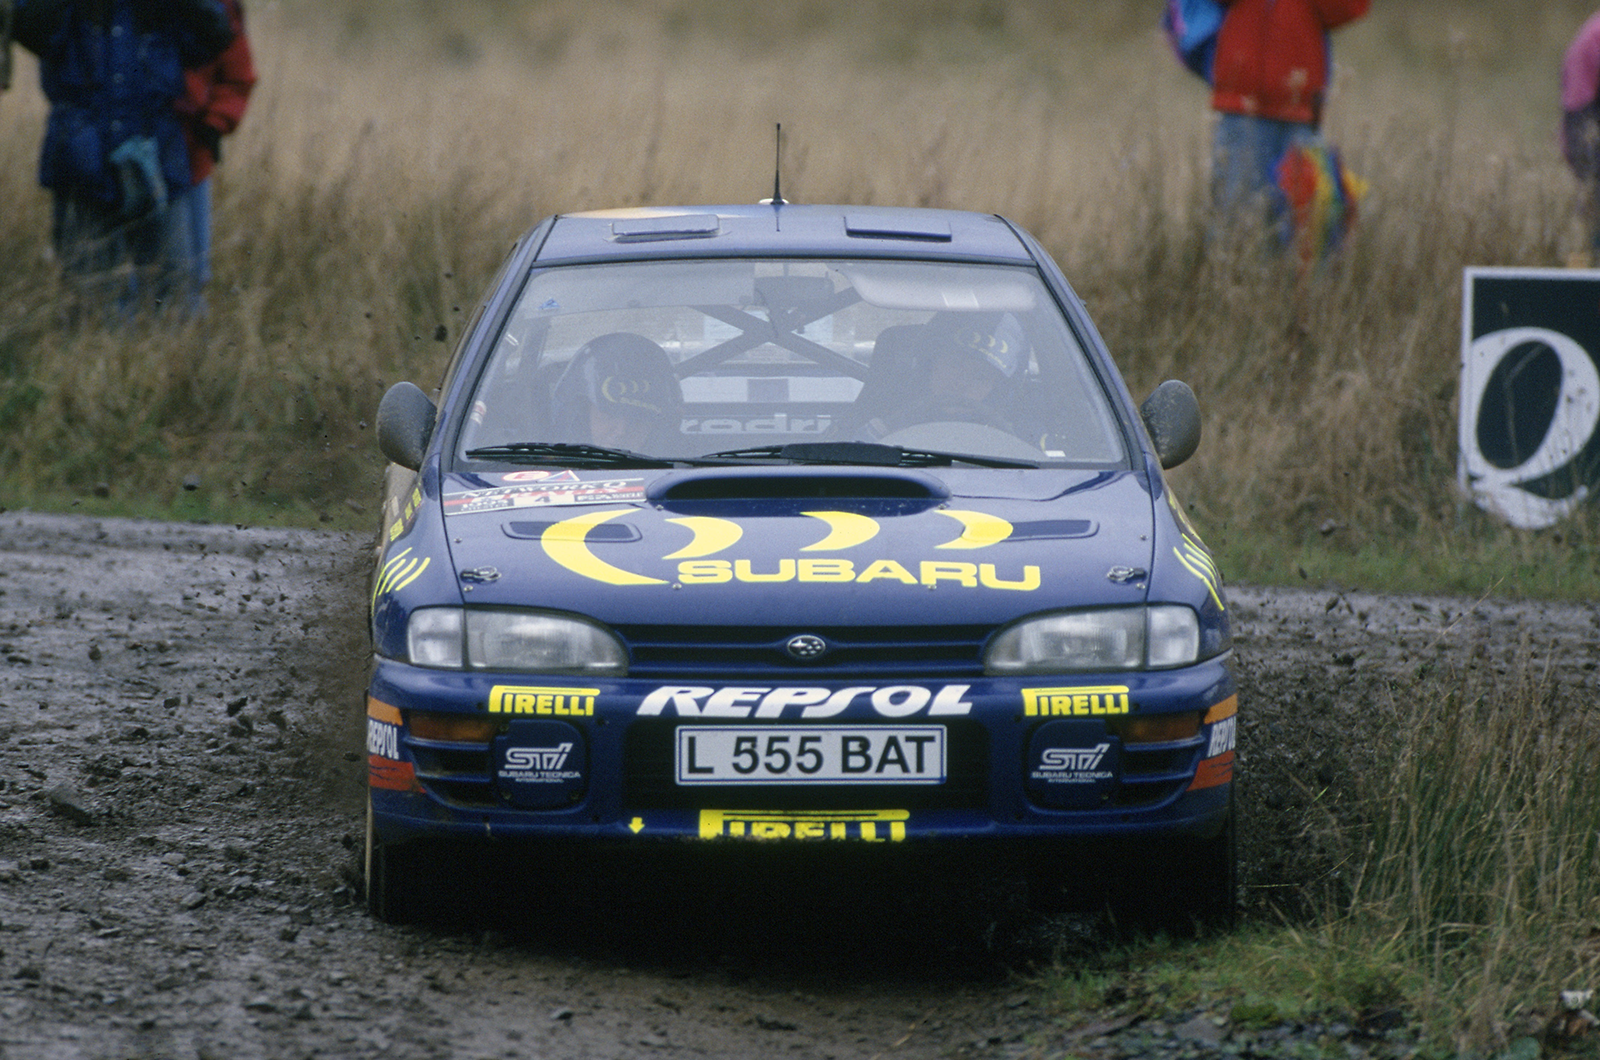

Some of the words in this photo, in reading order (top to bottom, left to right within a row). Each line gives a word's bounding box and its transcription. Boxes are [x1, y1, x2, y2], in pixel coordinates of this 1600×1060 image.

[463, 484, 597, 498] NETWORK
[534, 495, 551, 504] 4
[677, 558, 1041, 592] SUBARU
[488, 685, 601, 716] PIRELLI
[636, 684, 973, 719] REPSOL
[1021, 685, 1129, 717] PIRELLI
[688, 736, 714, 774] L
[732, 736, 824, 774] 555
[842, 736, 936, 774] BAT
[1031, 771, 1073, 779] SUBARU
